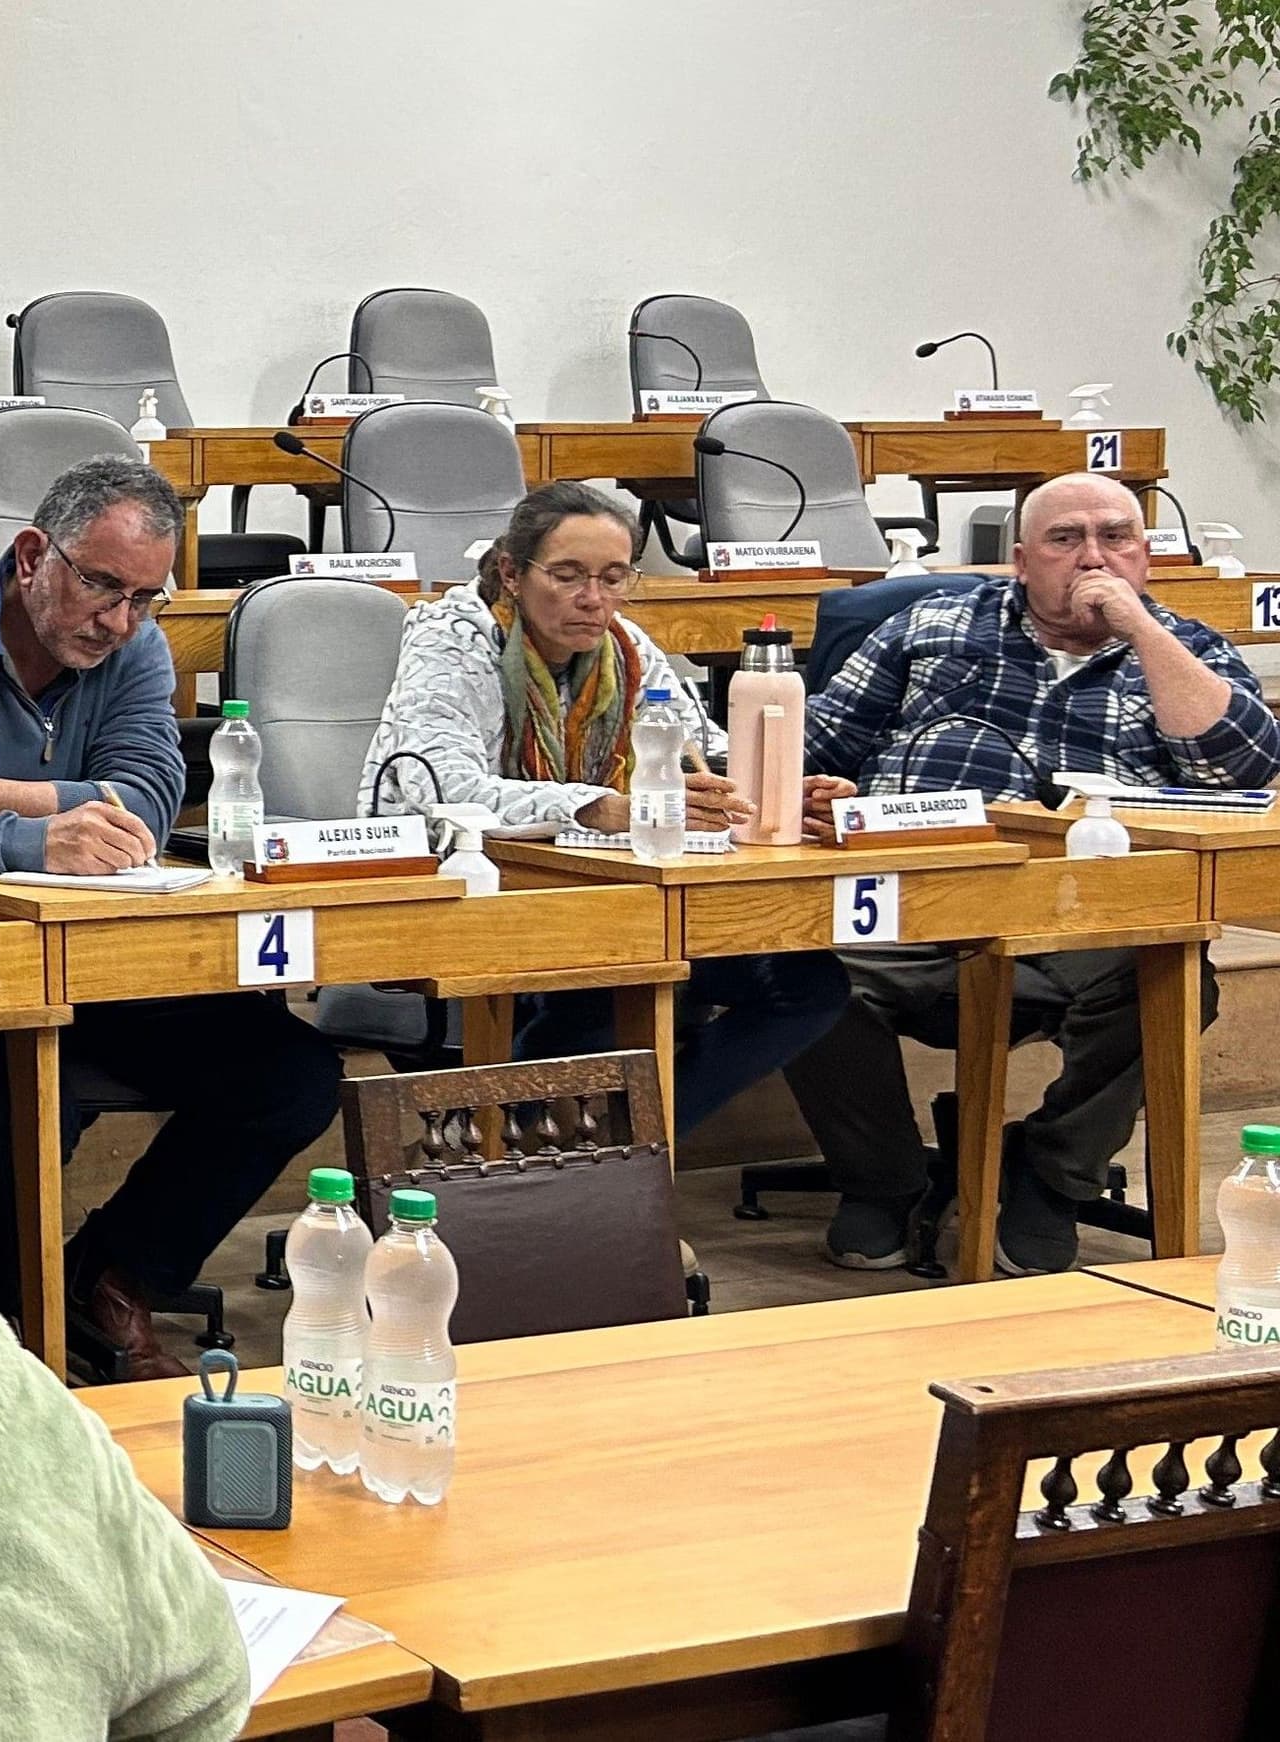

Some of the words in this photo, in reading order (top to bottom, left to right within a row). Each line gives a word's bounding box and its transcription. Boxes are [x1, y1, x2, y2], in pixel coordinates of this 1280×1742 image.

[1090, 435, 1118, 469] 21
[734, 547, 764, 556] MATEO
[881, 801, 918, 815] DANIEL
[920, 798, 968, 812] BARROZO
[318, 828, 362, 842] ALEXIS
[366, 826, 400, 840] SUHR
[851, 877, 878, 935] 5
[257, 914, 289, 976] 4
[1216, 1315, 1280, 1345] AGUA
[287, 1367, 352, 1397] AGUA
[365, 1392, 434, 1422] AGUA
